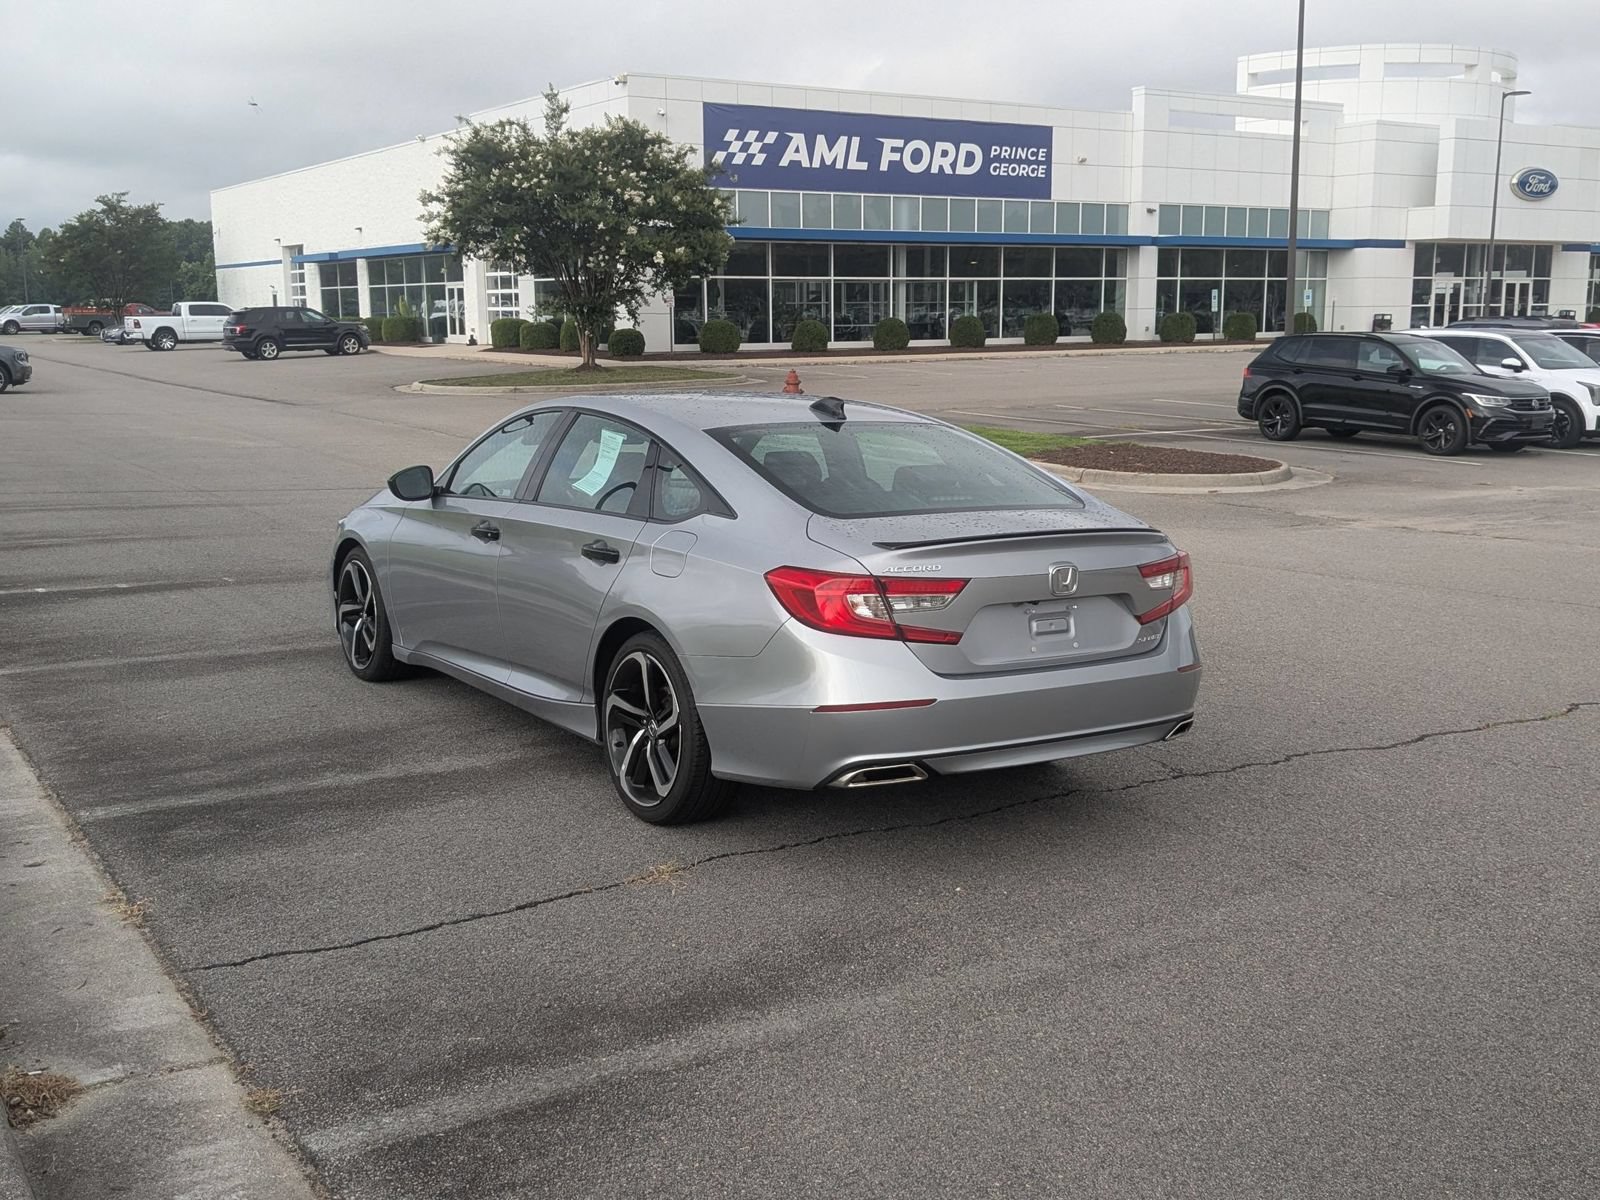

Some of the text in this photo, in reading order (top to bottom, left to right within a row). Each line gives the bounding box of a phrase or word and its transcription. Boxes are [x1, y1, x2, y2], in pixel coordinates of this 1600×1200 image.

[779, 132, 983, 176] AML FORD
[990, 145, 1047, 161] PRINCE
[989, 163, 1047, 178] GEORGE
[1525, 174, 1552, 193] Ford
[882, 564, 942, 574] ACCORD
